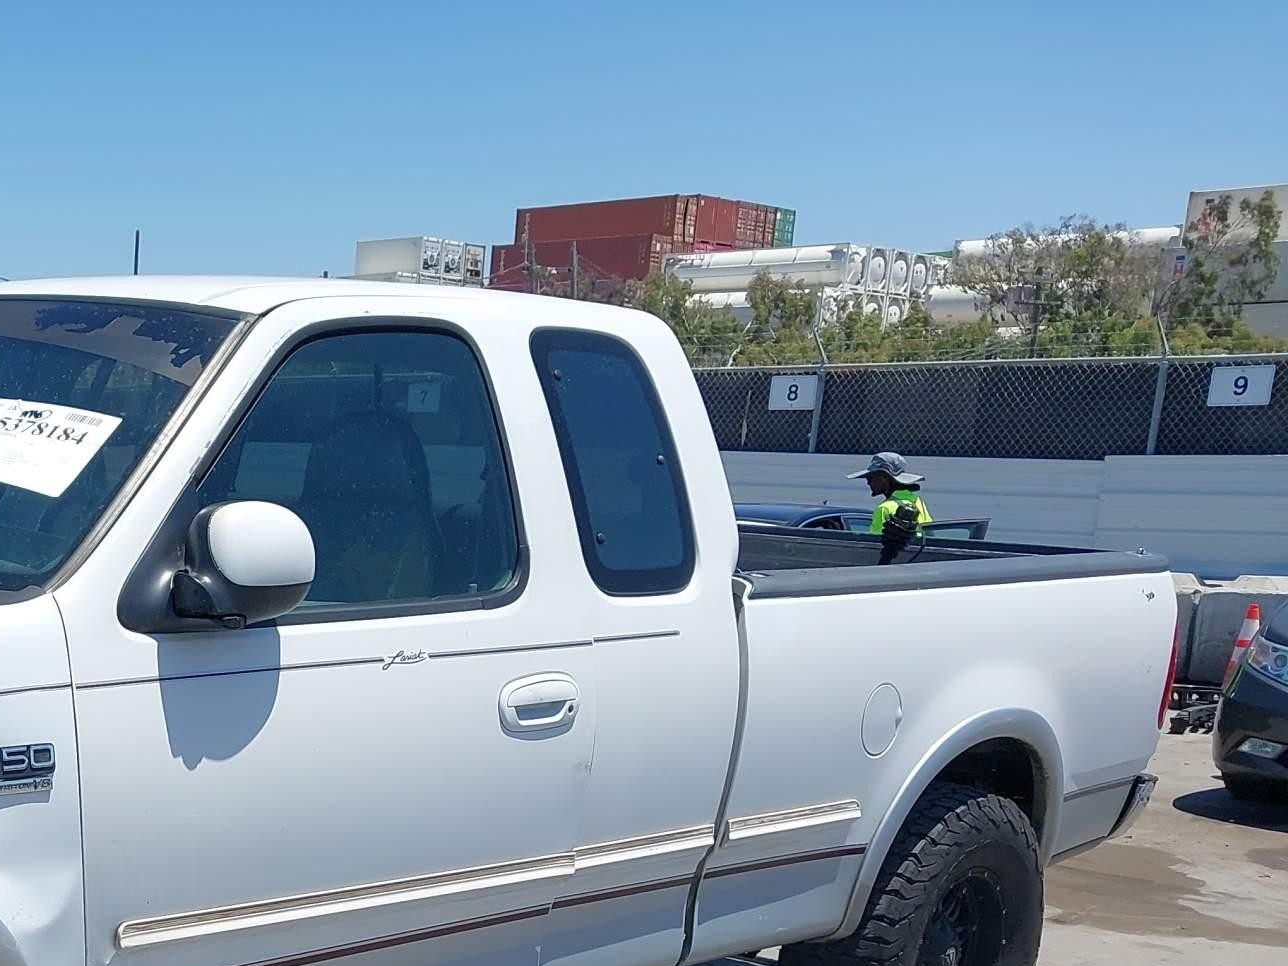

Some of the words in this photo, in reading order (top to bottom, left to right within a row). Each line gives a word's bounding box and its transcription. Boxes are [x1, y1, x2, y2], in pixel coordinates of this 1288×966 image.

[787, 383, 799, 402] 8
[1232, 375, 1249, 396] 9
[419, 389, 429, 405] 7
[382, 648, 427, 671] Lariat
